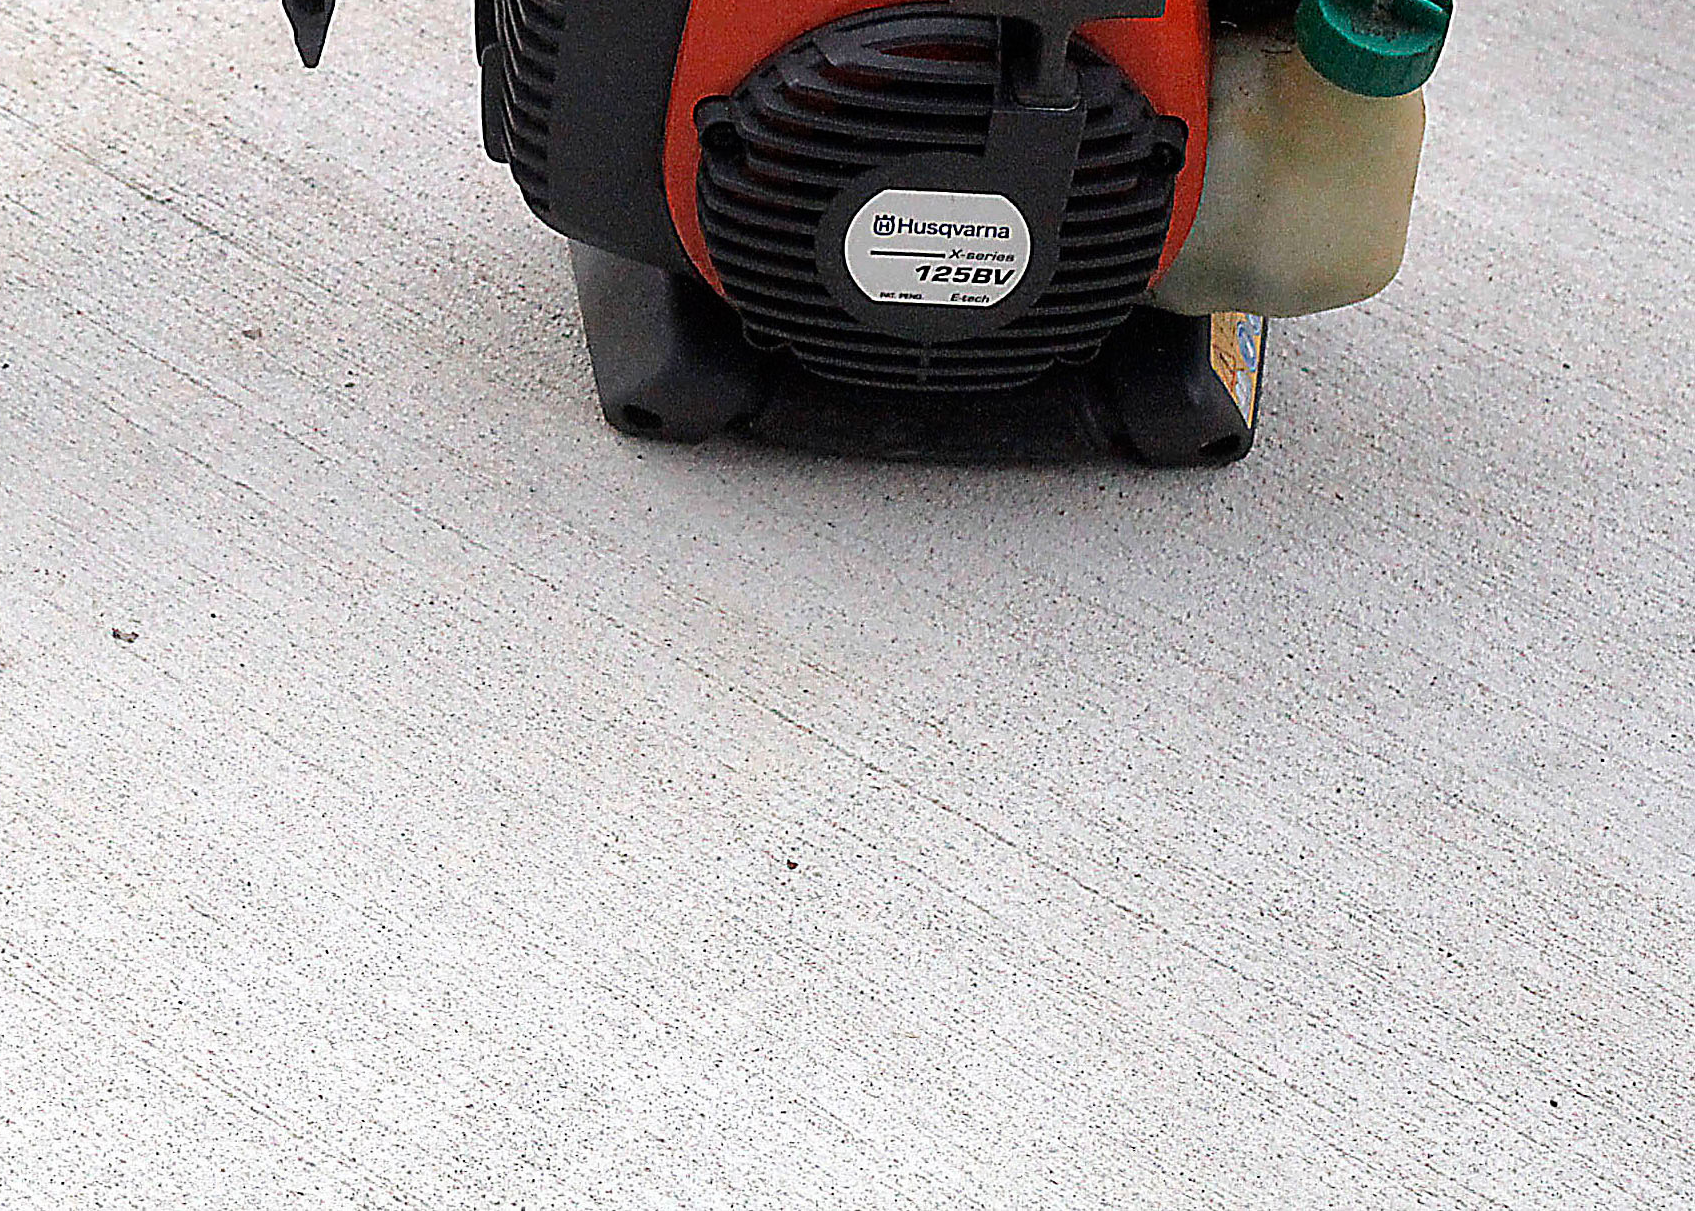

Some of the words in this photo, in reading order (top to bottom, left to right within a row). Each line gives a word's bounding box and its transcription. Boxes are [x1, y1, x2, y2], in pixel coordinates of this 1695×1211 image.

[897, 218, 1010, 239] Husqvarna
[948, 249, 1015, 262] X-series
[915, 265, 1015, 285] 125BV
[950, 293, 990, 303] E-tech
